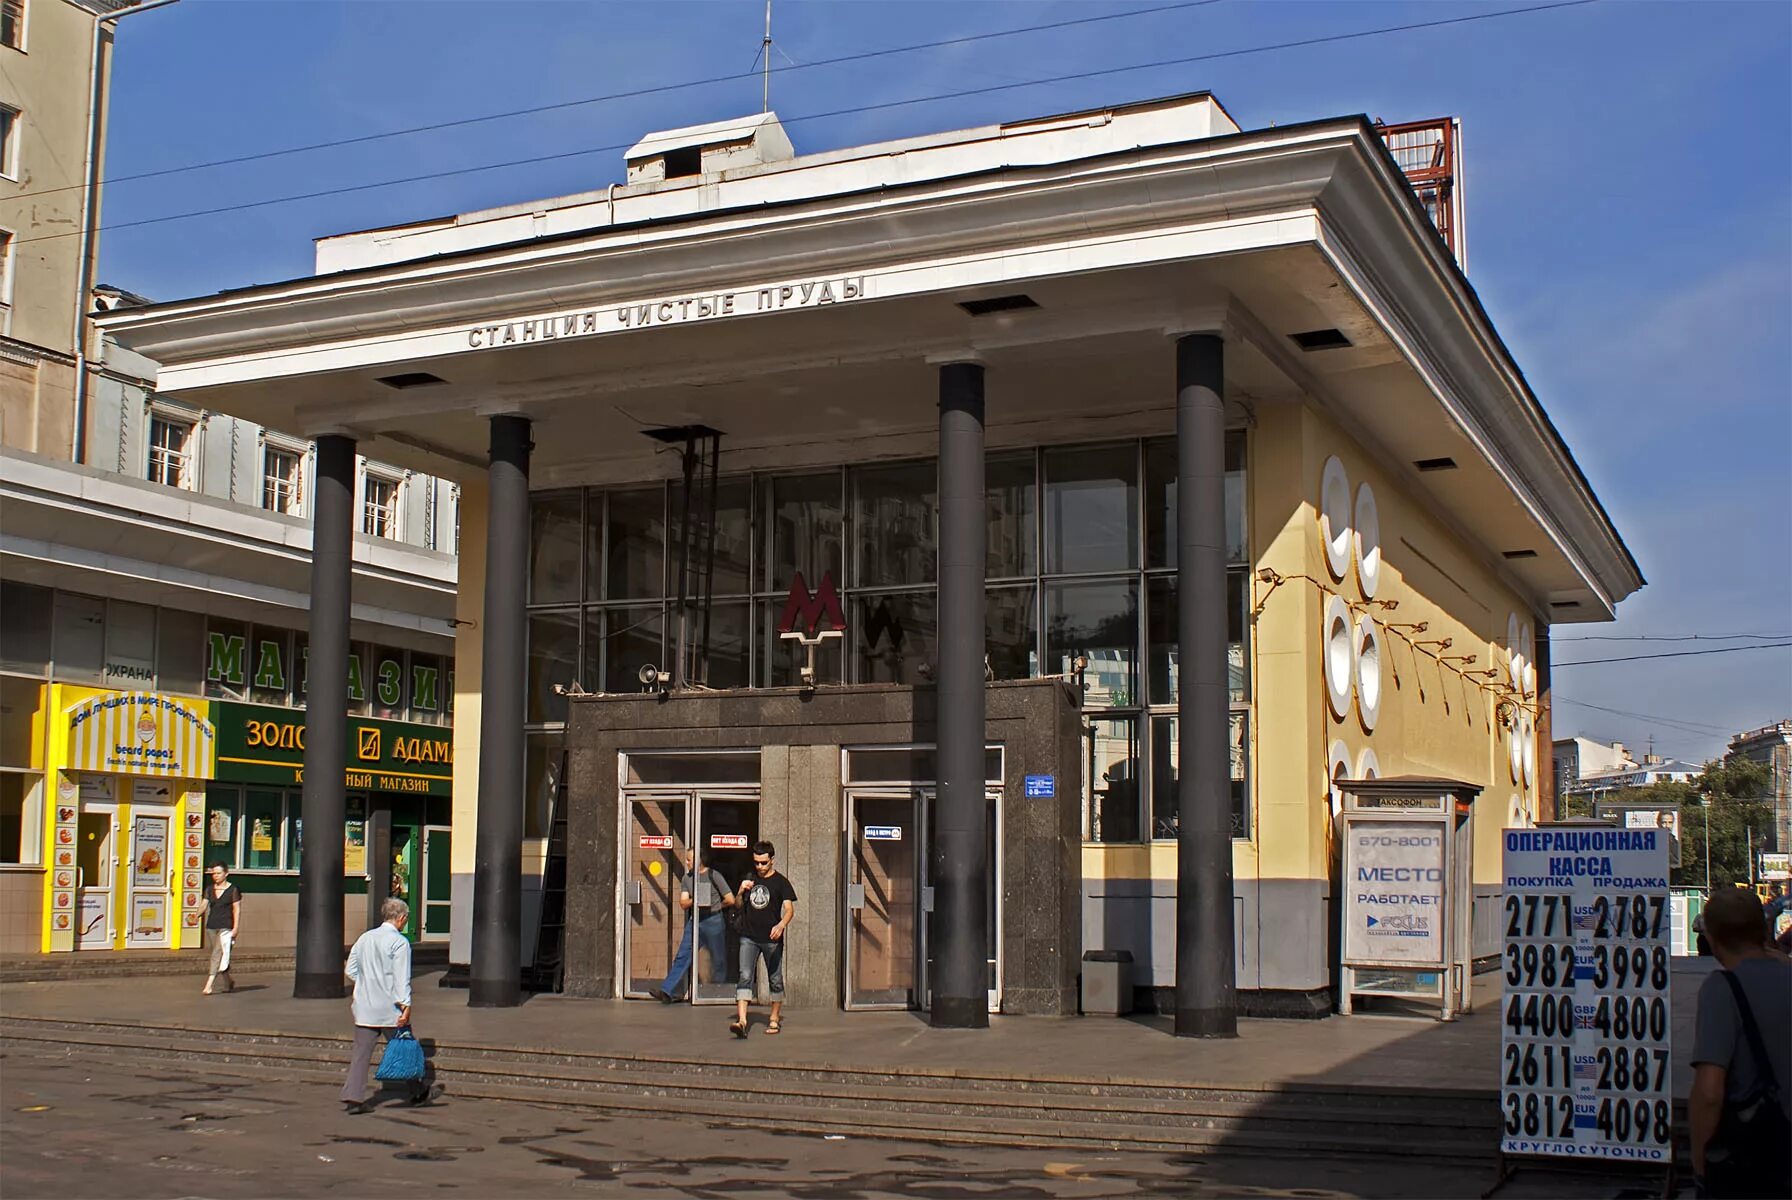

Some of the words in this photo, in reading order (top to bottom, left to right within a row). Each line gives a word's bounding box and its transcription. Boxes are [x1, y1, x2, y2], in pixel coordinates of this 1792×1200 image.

[468, 311, 597, 347] СТАНЦИЯ
[617, 293, 735, 327] ЧИСТЫЕ
[757, 275, 864, 309] ПРУДЫ
[777, 570, 847, 633] М
[115, 744, 143, 756] beard
[380, 776, 429, 792] МАГАЗИН
[1376, 798, 1422, 807] ТАКСОФОН
[1507, 831, 1656, 853] ОПЕРАЦИОННАЯ
[1358, 867, 1442, 882] МЕСТО
[1550, 857, 1612, 876] КАССА
[1507, 877, 1573, 887] ПОКУПКА
[1593, 878, 1667, 889] ПРОДАЖА
[1506, 895, 1573, 937] 2771
[1594, 895, 1665, 939] 2787
[1506, 943, 1575, 988] 3982
[1575, 955, 1594, 965] EUR
[1593, 945, 1668, 991] 3998
[1506, 994, 1573, 1038] 4400
[1574, 1006, 1596, 1014] GBP
[1595, 995, 1666, 1041] 4800
[1506, 1043, 1571, 1088] 2611
[1574, 1055, 1596, 1064] USD
[1596, 1046, 1669, 1092] 2887
[1506, 1092, 1574, 1138] 3812
[1575, 1104, 1596, 1114] EUR
[1597, 1097, 1670, 1144] 4098
[1508, 1141, 1662, 1159] КРУГЛОСУТОЧНО
